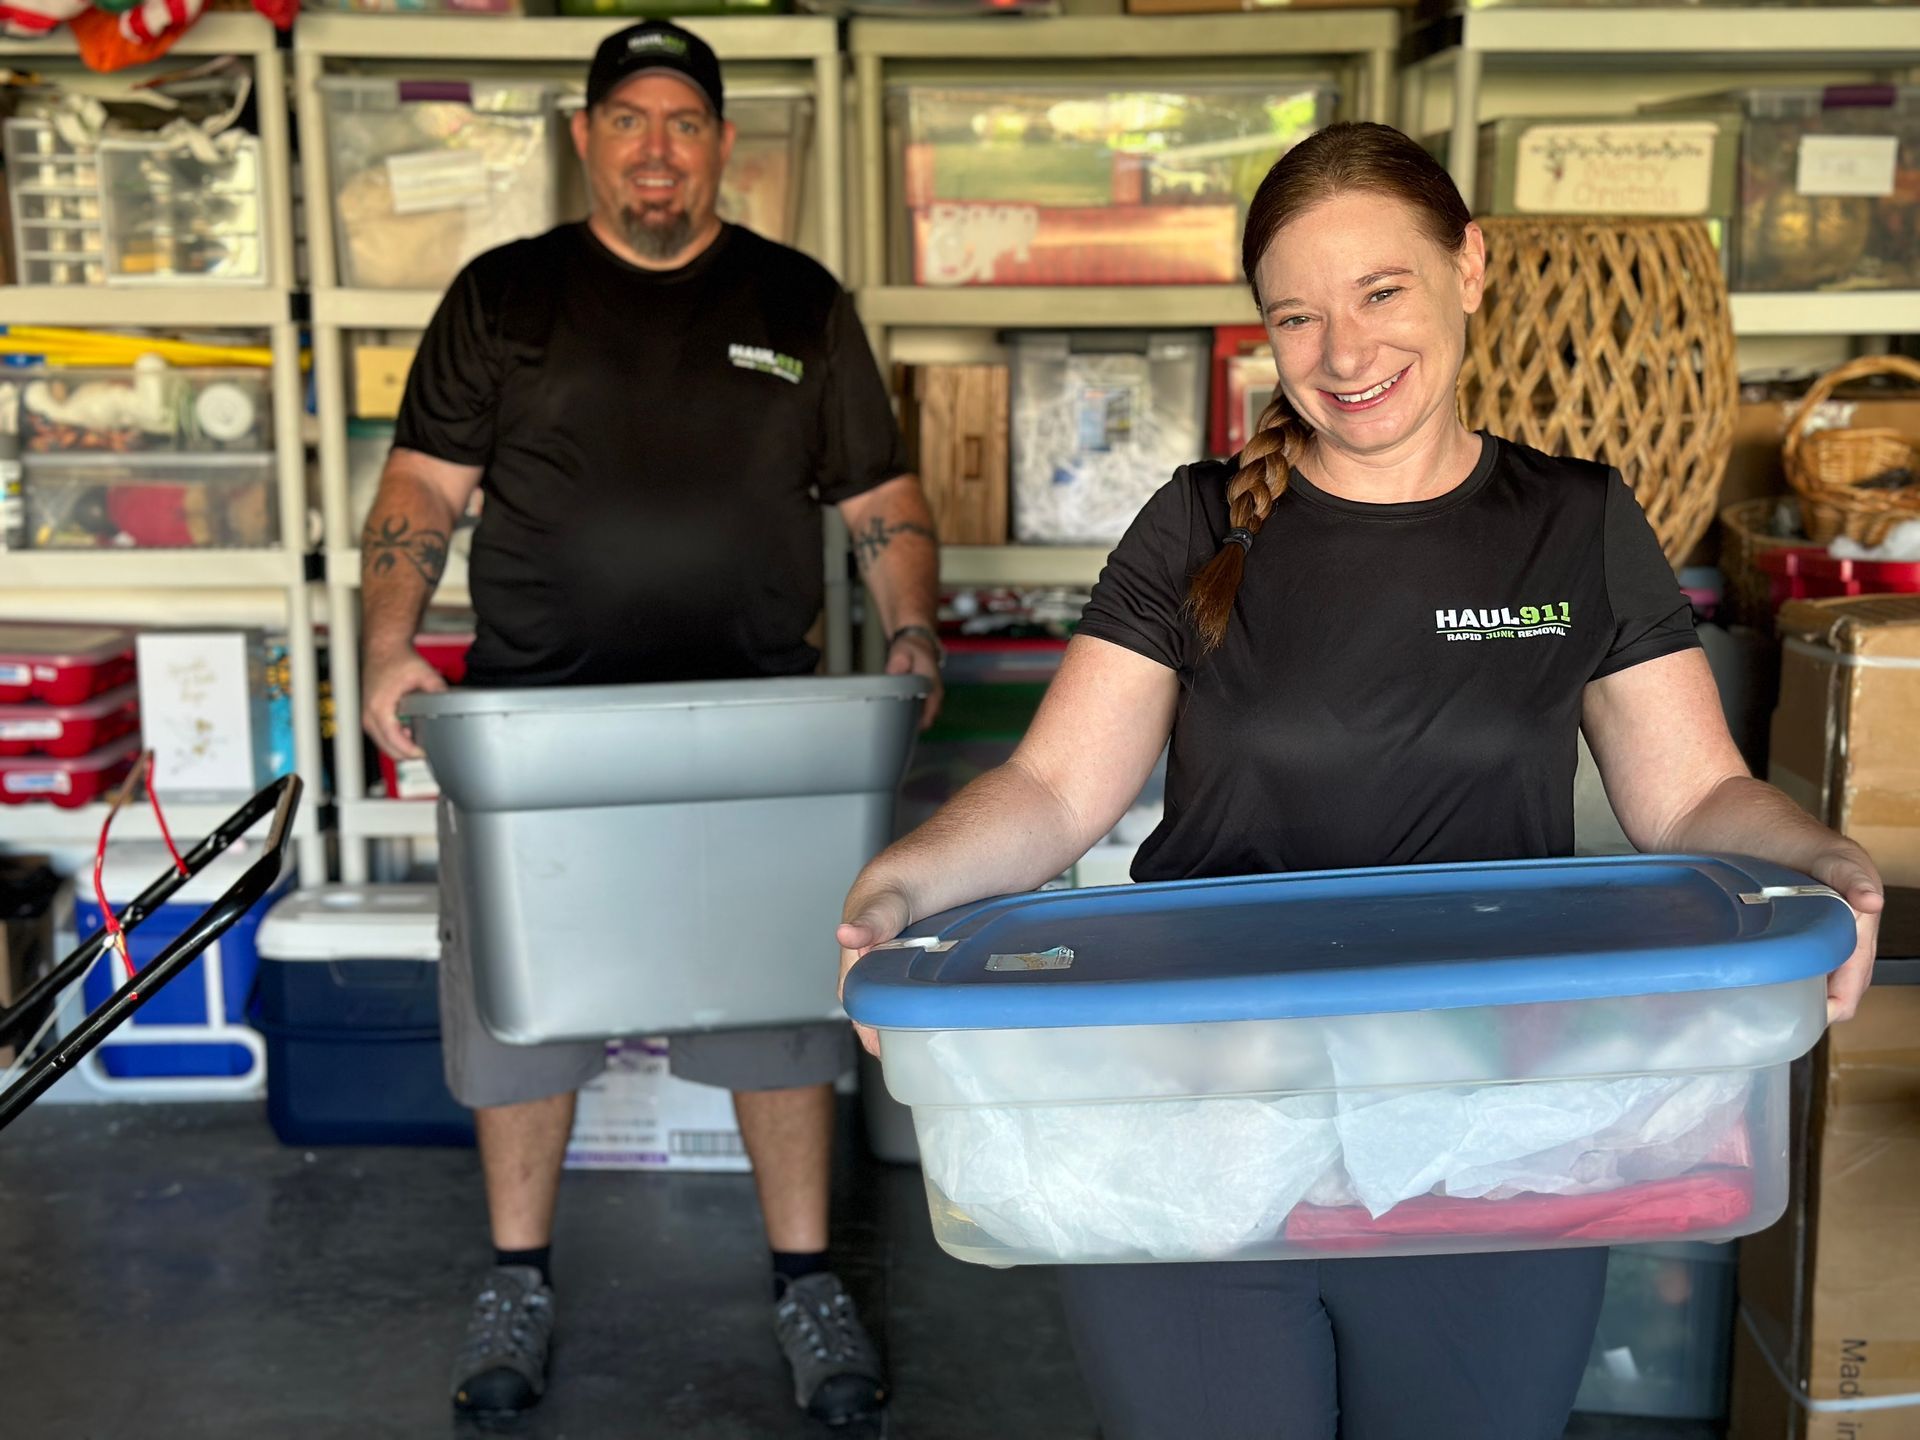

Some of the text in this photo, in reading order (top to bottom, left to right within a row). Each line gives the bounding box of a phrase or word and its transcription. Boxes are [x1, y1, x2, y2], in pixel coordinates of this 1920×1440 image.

[1446, 626, 1566, 641] RAPID JUNK REMOVAL
[1839, 1339, 1867, 1412] Mad
